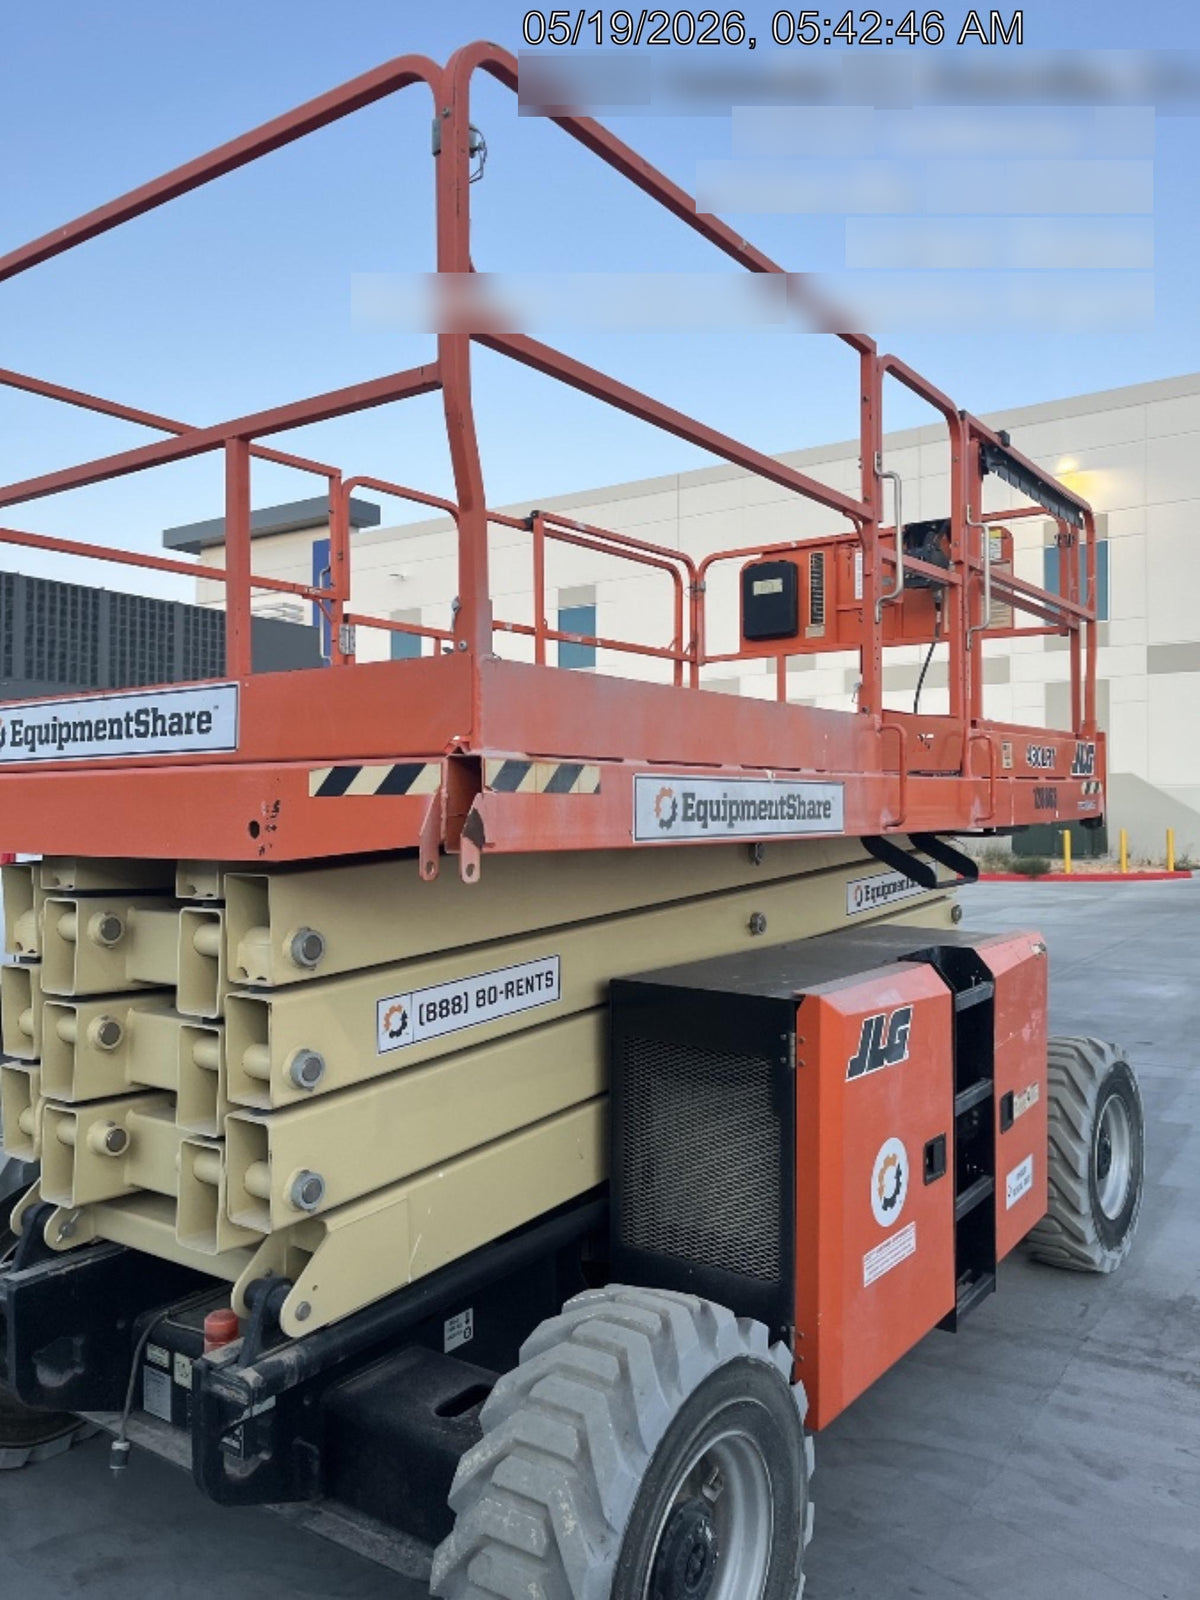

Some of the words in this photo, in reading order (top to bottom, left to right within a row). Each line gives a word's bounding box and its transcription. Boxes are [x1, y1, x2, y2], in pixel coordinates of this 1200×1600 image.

[9, 706, 213, 752] EquipmentShare
[681, 791, 832, 829] EquipmentShare
[418, 991, 469, 1027] (888)
[475, 970, 554, 1008] 80-RENTS
[845, 1004, 914, 1083] JLG
